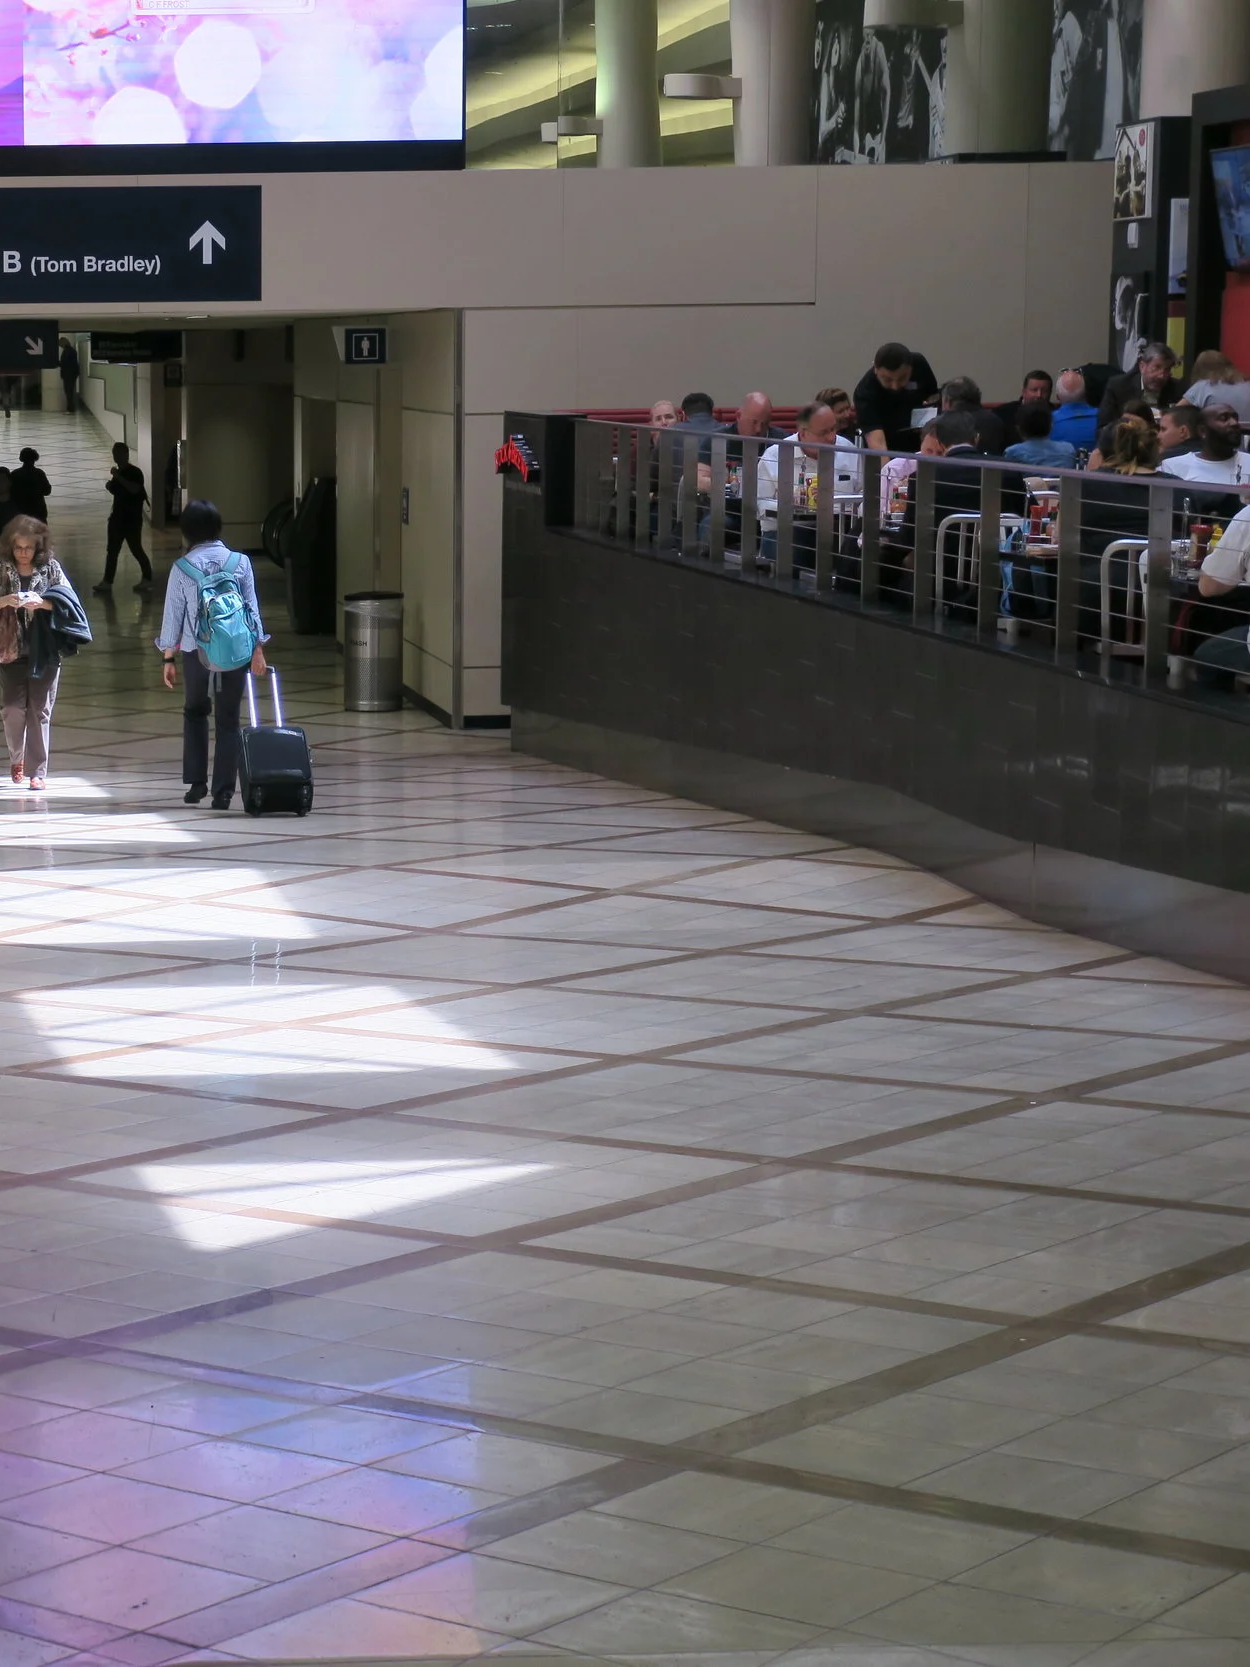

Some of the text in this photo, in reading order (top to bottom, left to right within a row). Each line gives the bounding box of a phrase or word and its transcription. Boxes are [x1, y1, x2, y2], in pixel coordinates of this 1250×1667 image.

[2, 250, 22, 273] B
[30, 255, 77, 276] (Tom
[83, 254, 161, 276] Bradley)
